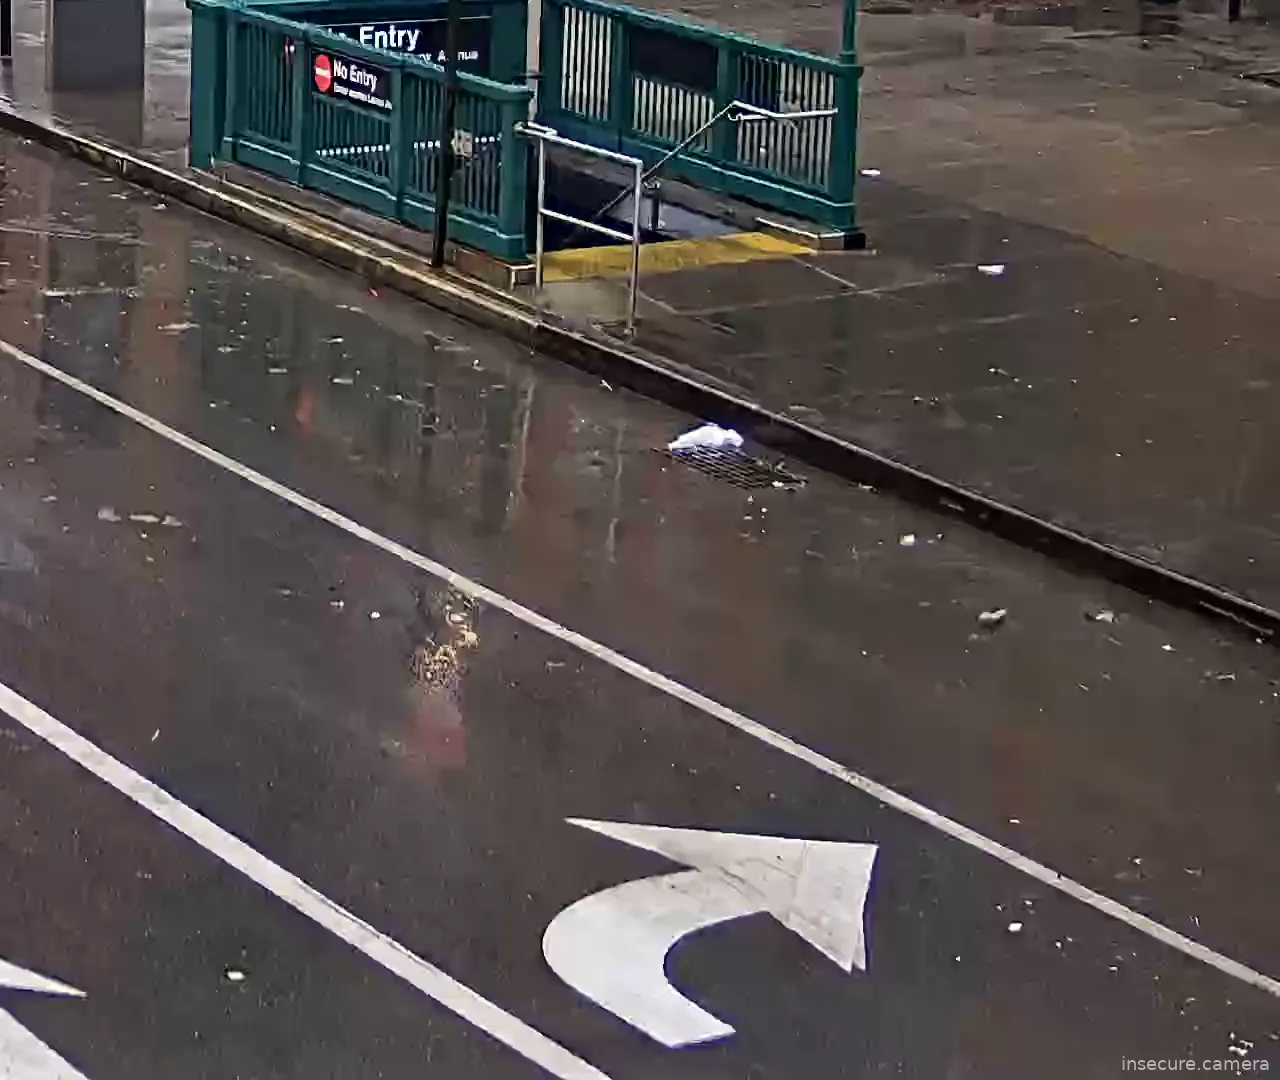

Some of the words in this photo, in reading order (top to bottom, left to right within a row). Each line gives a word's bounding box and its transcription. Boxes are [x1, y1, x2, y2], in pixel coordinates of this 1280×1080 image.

[359, 24, 421, 52] Entry
[437, 49, 479, 62] Anue
[333, 59, 347, 80] No
[349, 64, 378, 93] Entry
